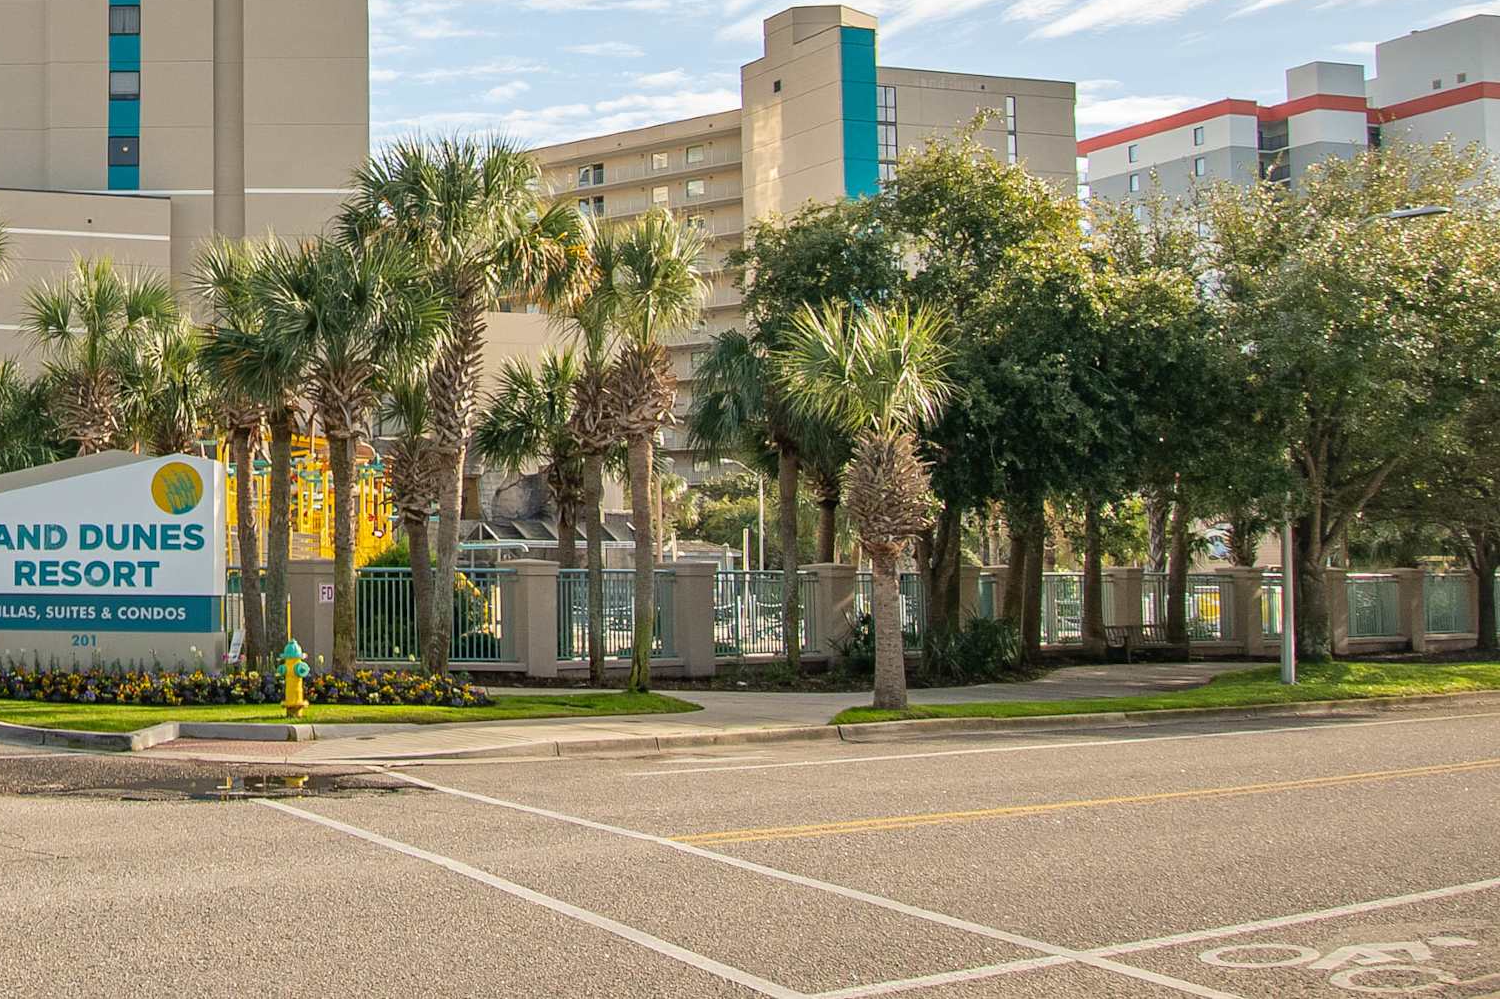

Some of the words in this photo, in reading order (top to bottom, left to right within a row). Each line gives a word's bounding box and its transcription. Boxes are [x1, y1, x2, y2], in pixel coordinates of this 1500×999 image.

[79, 524, 205, 550] DUNES
[14, 560, 160, 587] RESORT
[45, 606, 96, 619] SUITES
[101, 607, 112, 619] &
[117, 607, 186, 620] CONDOS
[72, 634, 97, 646] 201
